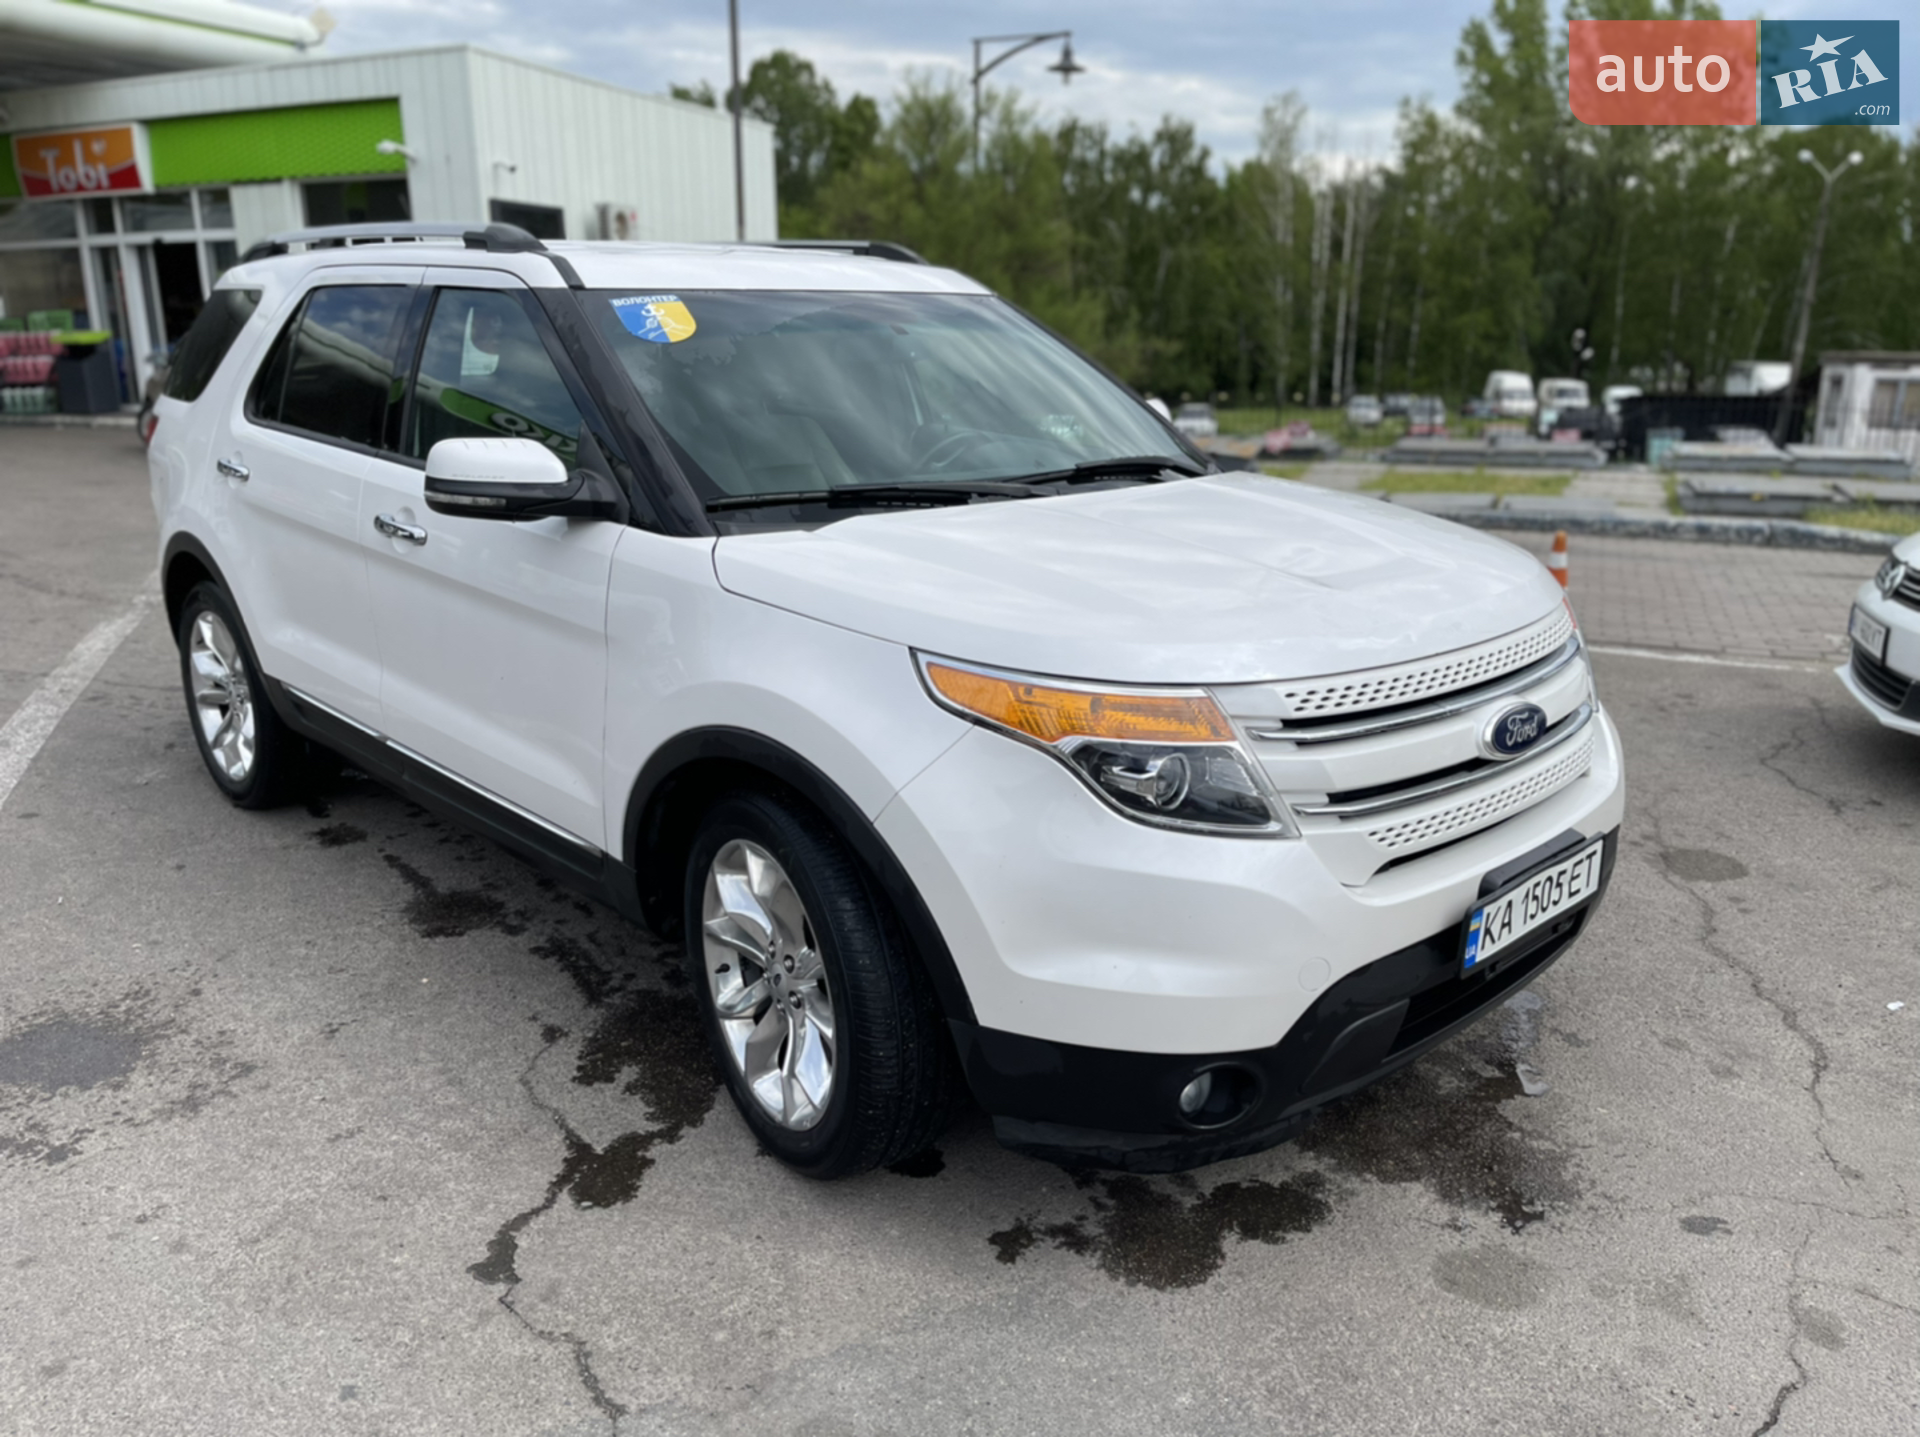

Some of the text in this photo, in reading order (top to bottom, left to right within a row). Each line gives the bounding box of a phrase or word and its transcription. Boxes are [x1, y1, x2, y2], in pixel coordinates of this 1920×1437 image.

[39, 137, 111, 193] Tobi
[612, 294, 678, 307] ВОЛОНТЕР
[1506, 711, 1539, 747] Ford
[1480, 850, 1598, 951] KA 1505 ET
